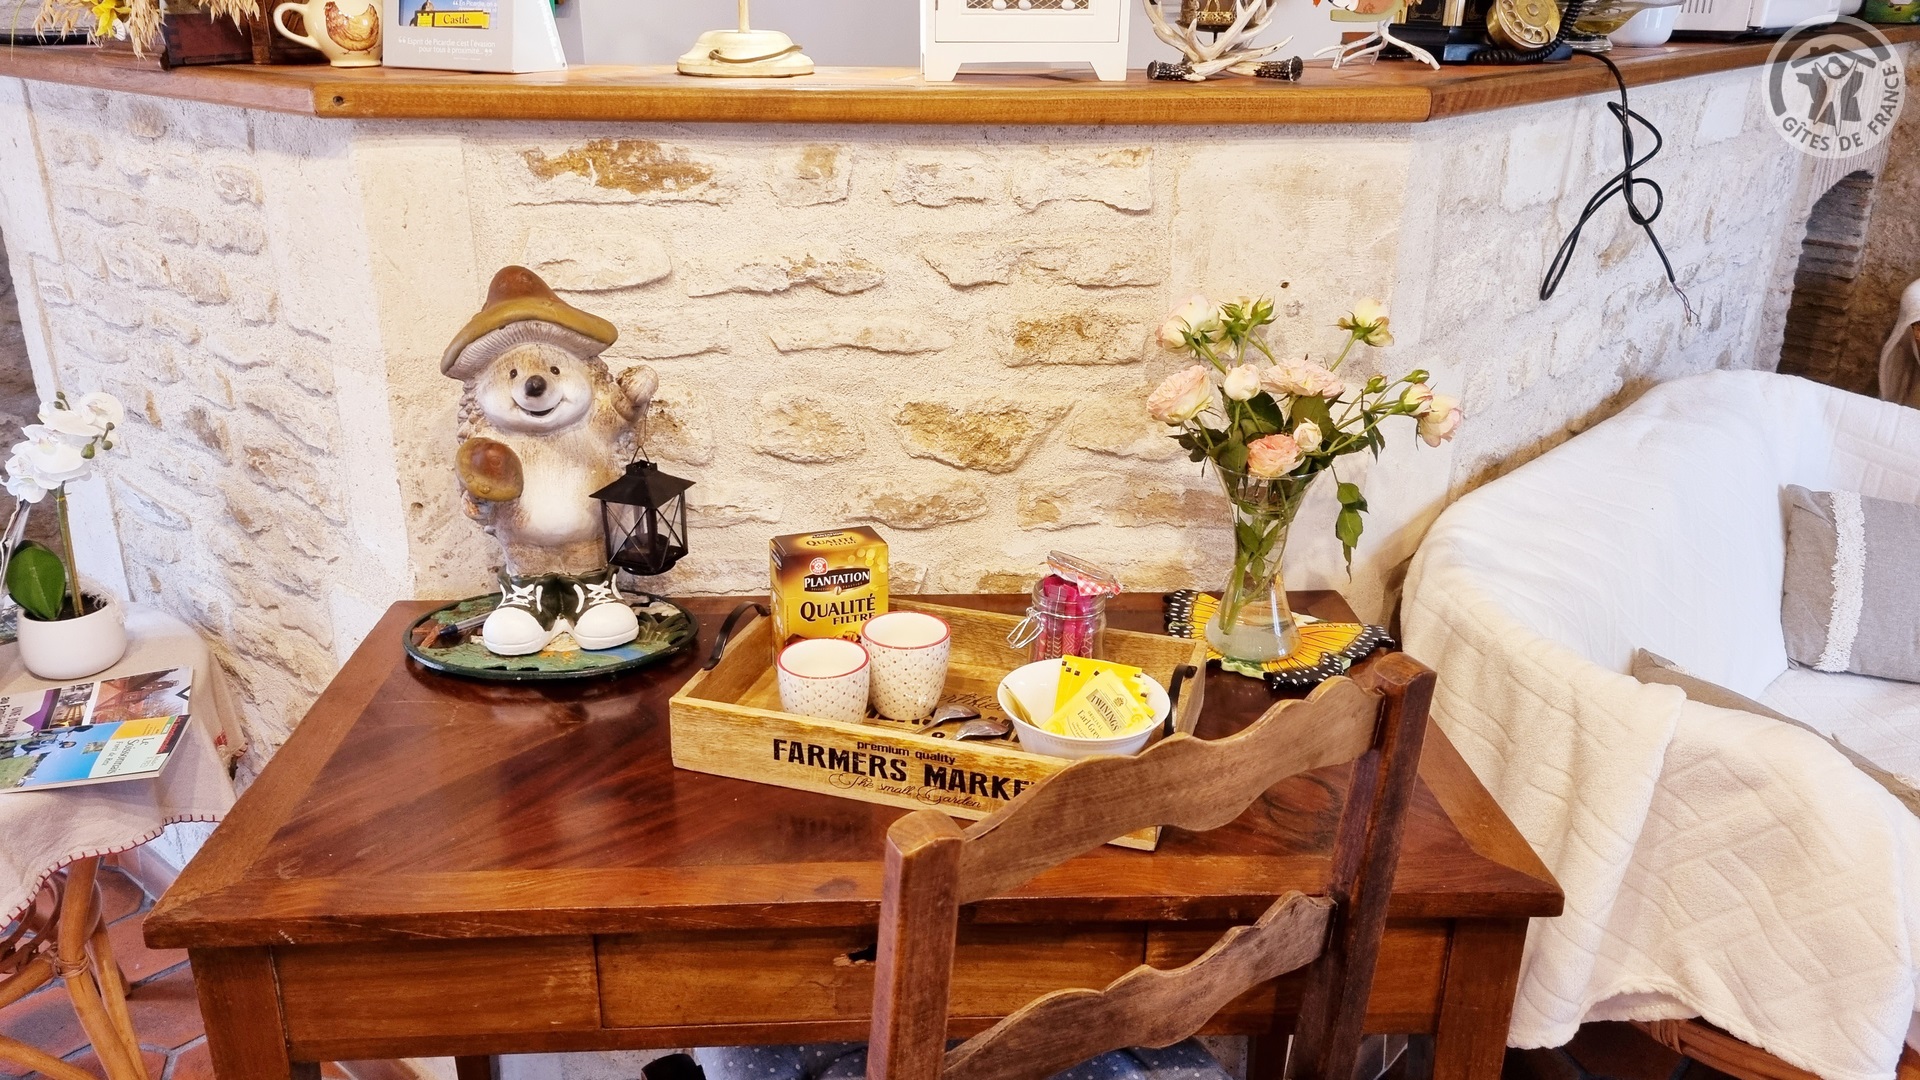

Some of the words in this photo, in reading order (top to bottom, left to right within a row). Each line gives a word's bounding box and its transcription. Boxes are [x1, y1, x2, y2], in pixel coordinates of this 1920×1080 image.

[443, 14, 470, 25] Castle
[418, 46, 433, 55] pour
[424, 38, 433, 46] de
[433, 38, 455, 47] Picardie
[804, 571, 870, 588] PLANTATION
[800, 593, 876, 622] QUALITÉ
[1077, 709, 1090, 726] Earl
[1091, 694, 1120, 732] TWININGS
[140, 737, 155, 746] Le
[857, 741, 909, 757] premium
[915, 750, 956, 765] quality
[773, 738, 907, 782] FARMERS
[923, 763, 1035, 801] MARKE
[829, 772, 874, 789] The
[879, 783, 916, 796] small
[916, 785, 982, 808] Garden
